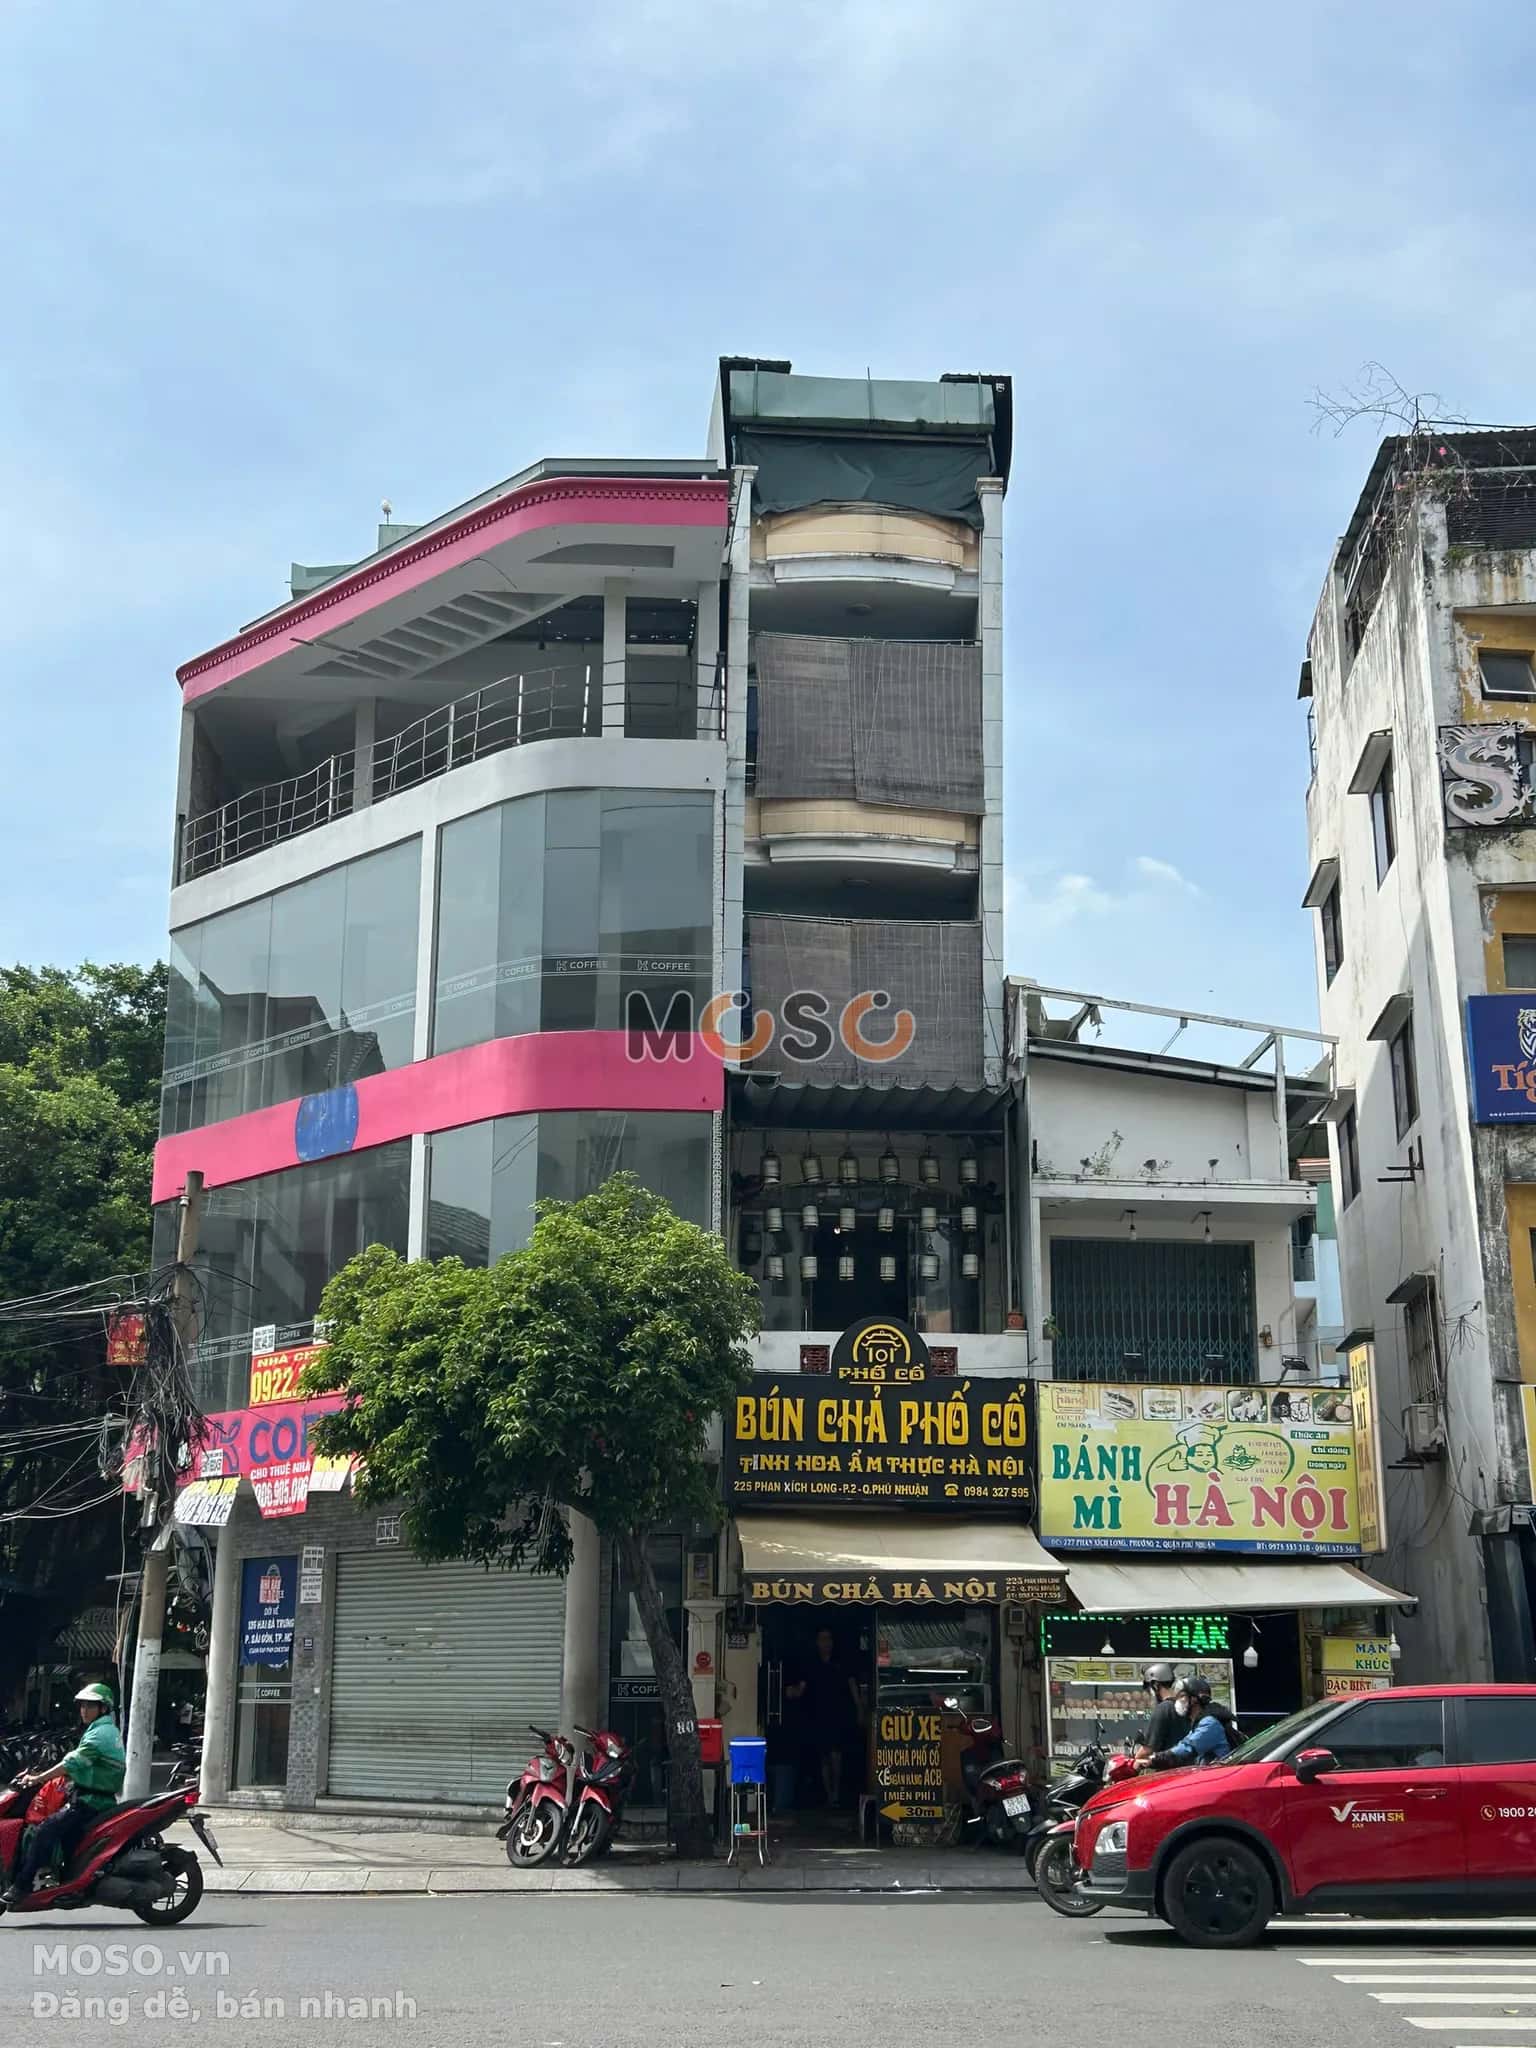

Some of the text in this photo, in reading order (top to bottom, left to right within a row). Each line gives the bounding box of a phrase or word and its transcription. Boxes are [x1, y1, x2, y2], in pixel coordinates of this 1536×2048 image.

[503, 963, 537, 977] COFFEE
[569, 960, 609, 969] COFFEE
[651, 961, 691, 971] COFFEE
[838, 1363, 925, 1381] PHỐ CỔ
[735, 1380, 1027, 1448] BÚN CHẢ PHỐ CỔ
[739, 1450, 1025, 1480] TINH HOA ẨM THỰC HÀ NỘI
[1052, 1434, 1143, 1482] BÁNH
[250, 1469, 268, 1480] CHO
[733, 1480, 752, 1492] 225
[754, 1481, 781, 1493] PHAN
[784, 1479, 808, 1493] XÍCH
[894, 1484, 929, 1498] NHUẬN
[964, 1486, 989, 1498] 0984
[992, 1487, 1009, 1498] 327
[1011, 1487, 1030, 1499] 595
[1073, 1485, 1122, 1530] MÌ
[1152, 1471, 1350, 1540] HÀ NỘI
[751, 1576, 997, 1601] BÚN CHẢ HÀ NỘI
[1006, 1577, 1023, 1585] 225
[1355, 1657, 1390, 1670] KHÚC
[260, 1688, 281, 1697] COFFEE
[881, 1708, 942, 1742] GIỮ XE
[877, 1742, 940, 1767] BÚN CHẢ PHỐ CỔ
[924, 1768, 943, 1787] ACB
[905, 1806, 935, 1818] 30m
[1352, 1812, 1405, 1823] XANH SM
[1498, 1807, 1536, 1818] 1900 2
